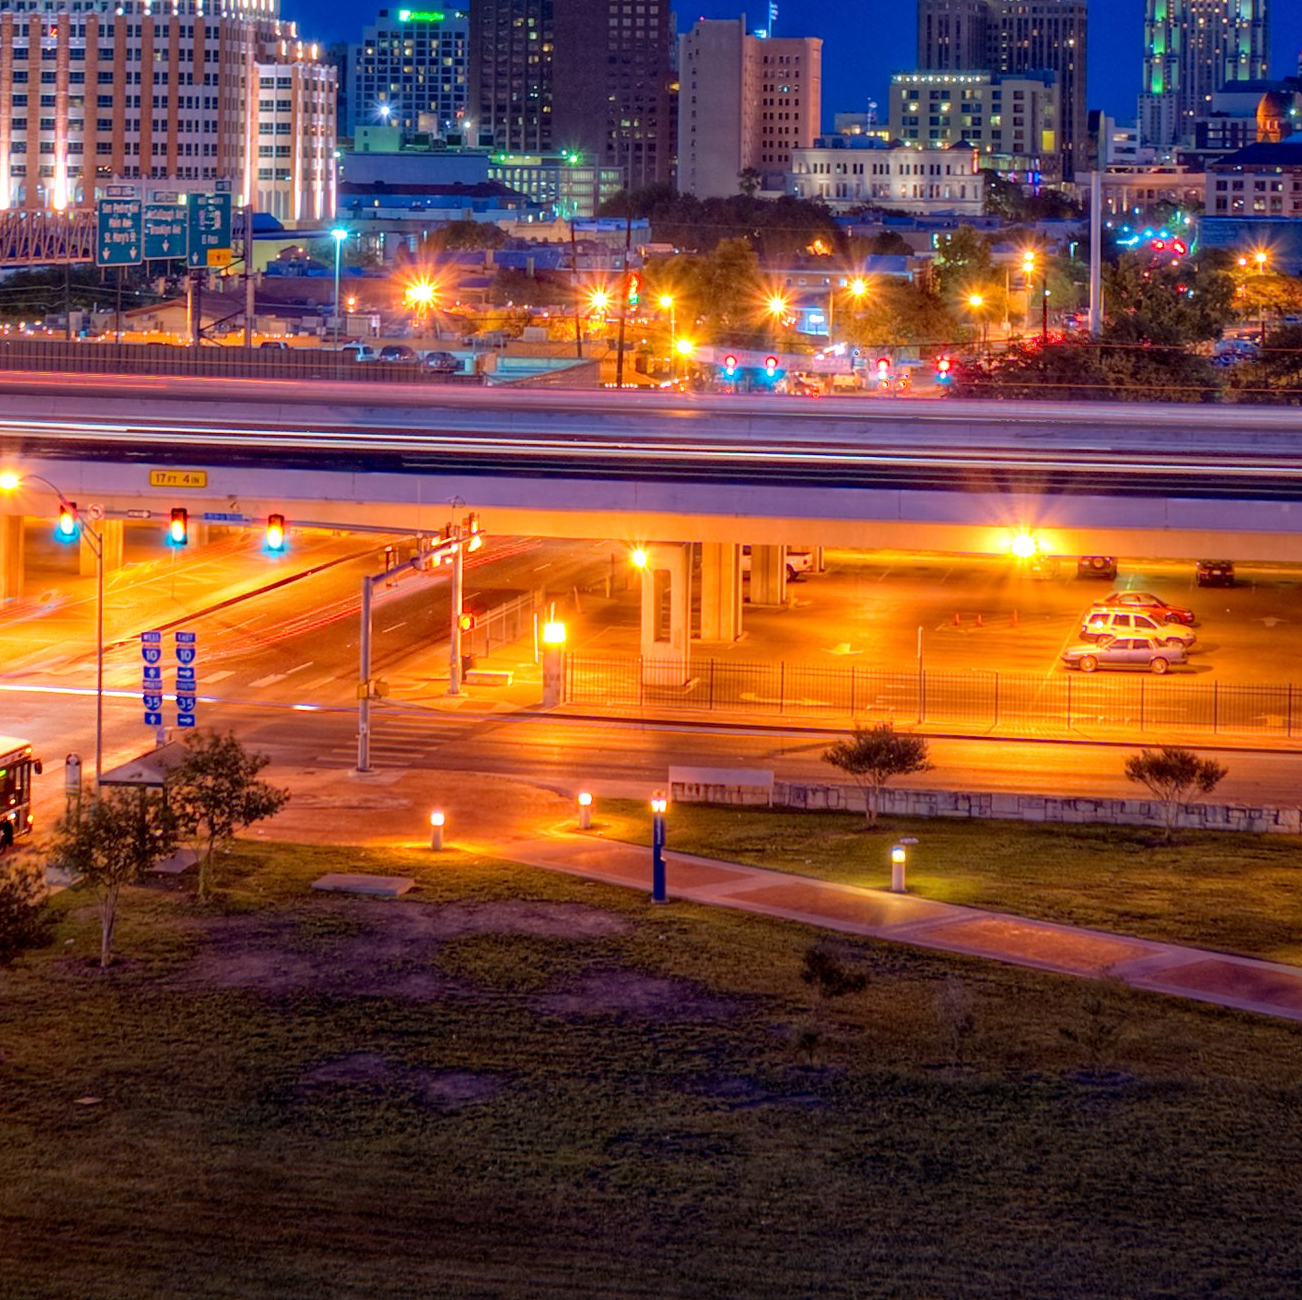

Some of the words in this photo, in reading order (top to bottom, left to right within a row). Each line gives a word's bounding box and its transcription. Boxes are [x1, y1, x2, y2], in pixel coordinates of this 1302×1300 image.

[156, 474, 166, 483] 17
[167, 475, 177, 483] FT
[183, 475, 190, 484] 4
[191, 476, 200, 484] IN
[145, 650, 158, 661] 10
[179, 650, 192, 661] 10
[146, 697, 160, 707] 35
[179, 698, 194, 709] 35
